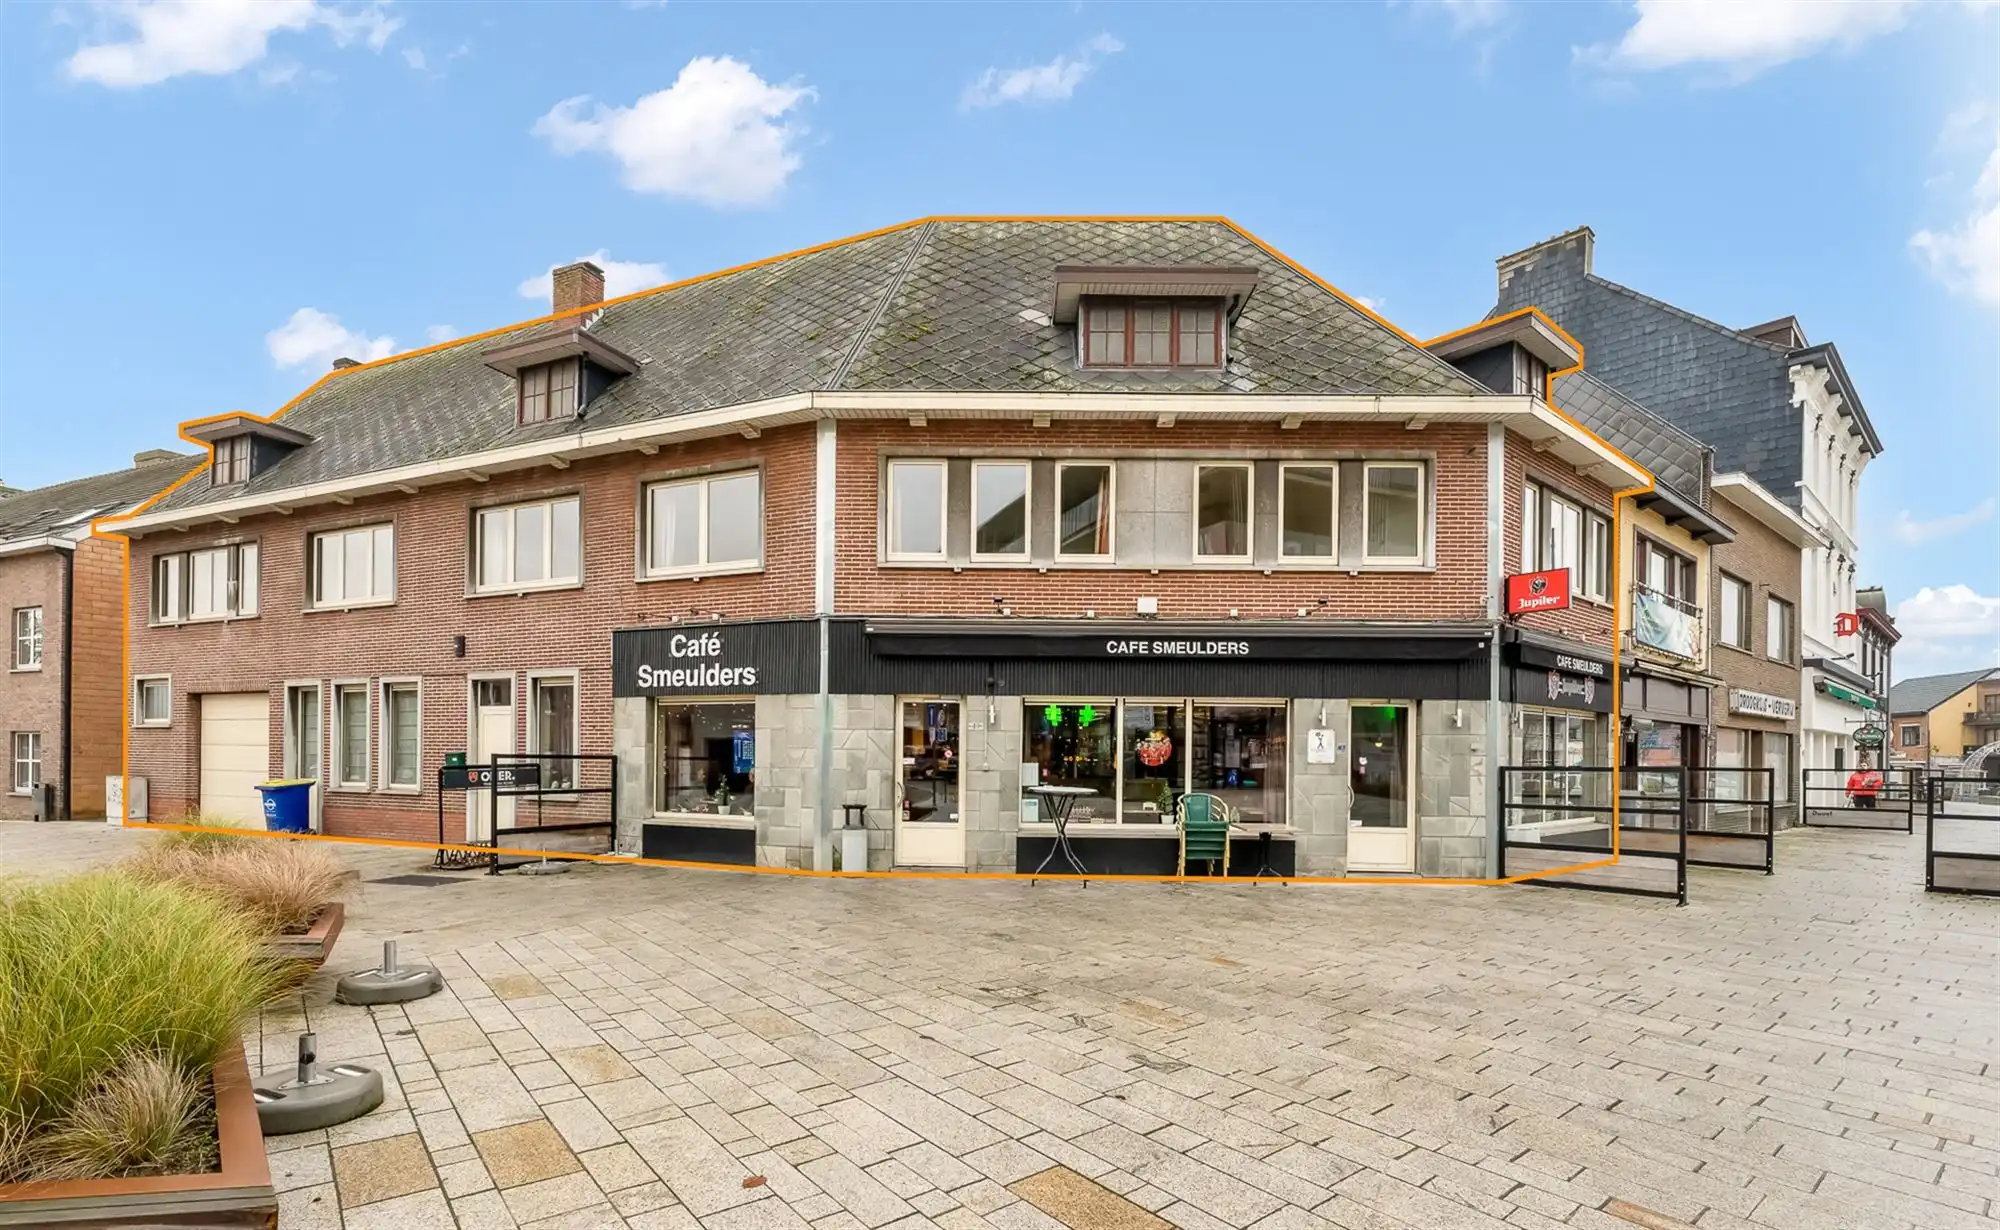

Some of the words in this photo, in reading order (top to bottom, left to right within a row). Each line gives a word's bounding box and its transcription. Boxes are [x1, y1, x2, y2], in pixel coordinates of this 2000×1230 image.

[1516, 596, 1560, 609] Jupiler
[670, 631, 721, 658] Café
[1106, 640, 1149, 654] CAFE
[1152, 641, 1249, 655] SMEULDERS
[637, 662, 756, 688] Smeulders
[1556, 654, 1572, 669] CAFE
[1572, 658, 1604, 675] SMEULDERS
